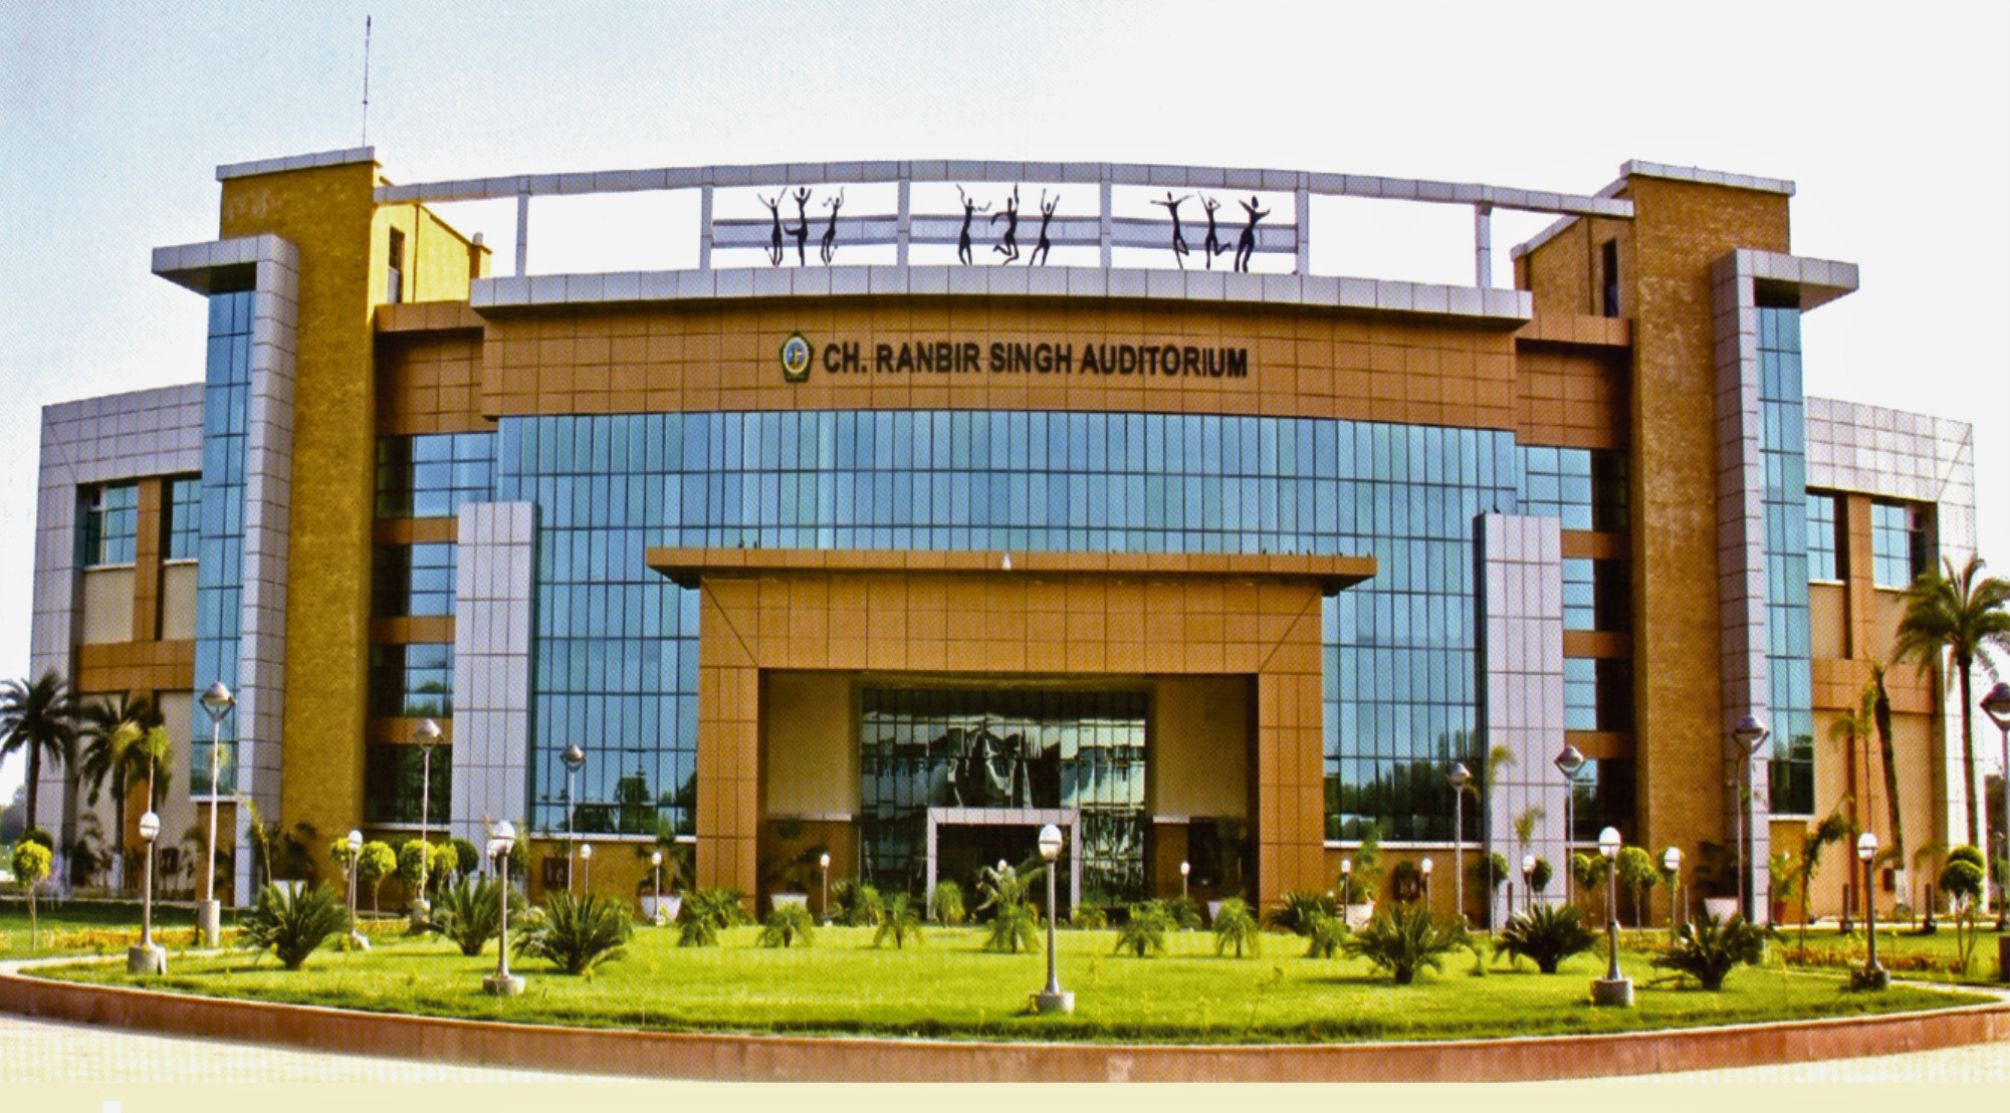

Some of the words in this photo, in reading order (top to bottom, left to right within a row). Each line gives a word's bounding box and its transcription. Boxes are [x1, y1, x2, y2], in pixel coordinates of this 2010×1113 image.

[823, 343, 868, 374] CH.
[876, 343, 981, 374] RANBIR
[990, 343, 1073, 375] SINGH
[1080, 345, 1248, 378] AUDITORIUM
